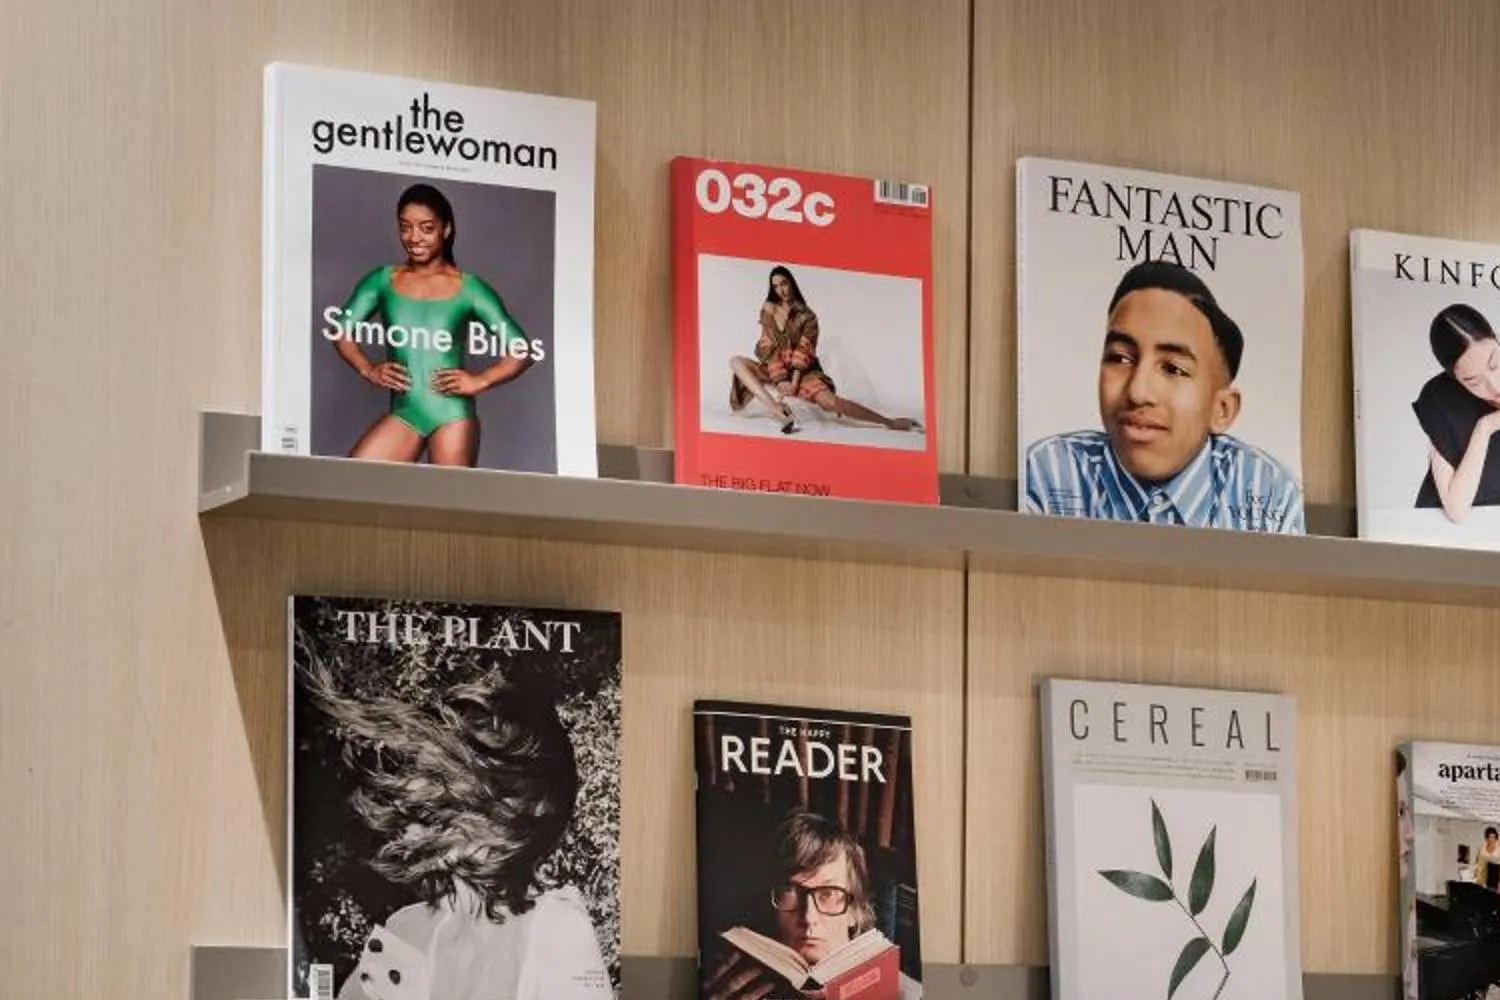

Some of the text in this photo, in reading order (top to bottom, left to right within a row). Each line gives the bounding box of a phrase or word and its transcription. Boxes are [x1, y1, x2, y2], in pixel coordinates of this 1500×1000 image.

[409, 92, 465, 133] the
[311, 114, 558, 171] gentlewoman
[695, 168, 836, 227] 032c
[1047, 175, 1284, 239] FANTASTIC
[1116, 226, 1218, 271] MAN
[322, 305, 546, 362] Simone Biles
[700, 473, 728, 489] THE
[337, 610, 581, 654] THE PLANT
[1070, 699, 1281, 753] CEREAL
[721, 735, 887, 784] READER
